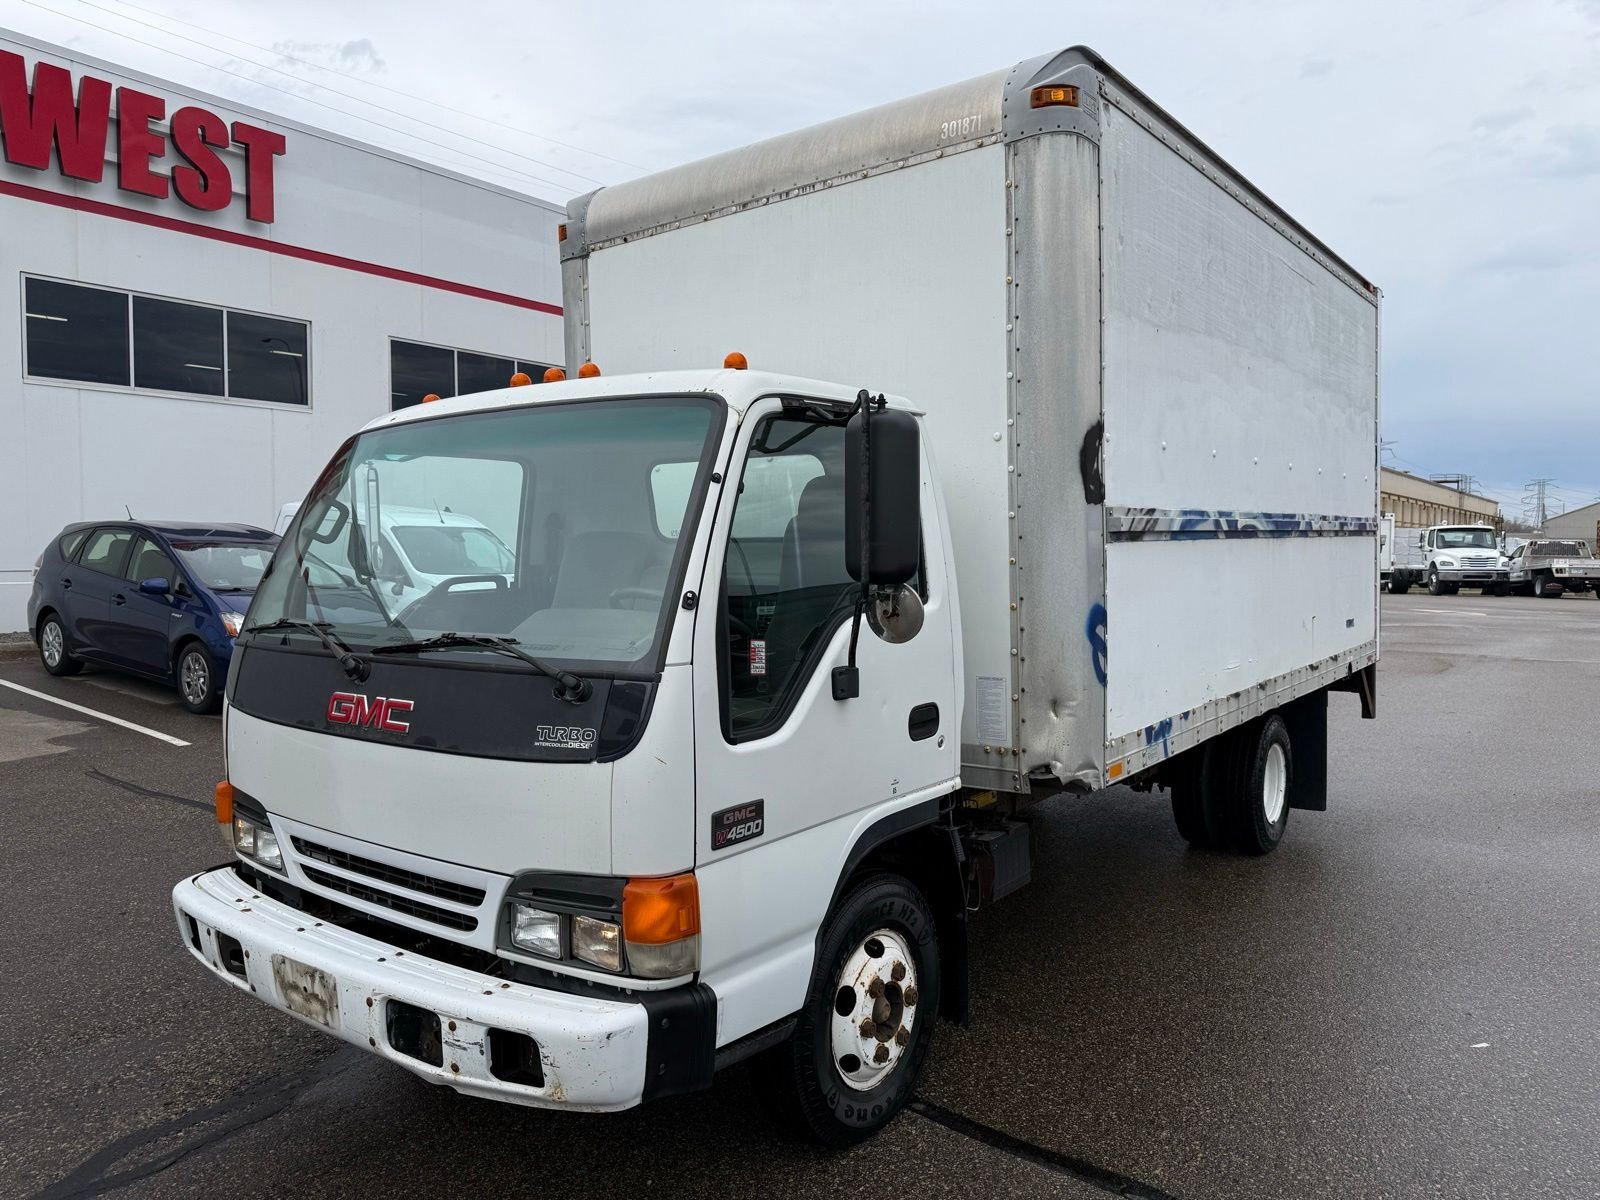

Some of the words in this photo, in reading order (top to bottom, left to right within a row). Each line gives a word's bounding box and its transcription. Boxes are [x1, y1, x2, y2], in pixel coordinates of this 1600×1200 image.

[0, 49, 286, 224] WEST
[941, 114, 982, 140] 301871
[327, 691, 415, 733] GMC
[537, 725, 597, 743] TURBO
[723, 806, 756, 824] GMC
[715, 819, 762, 845] W4500
